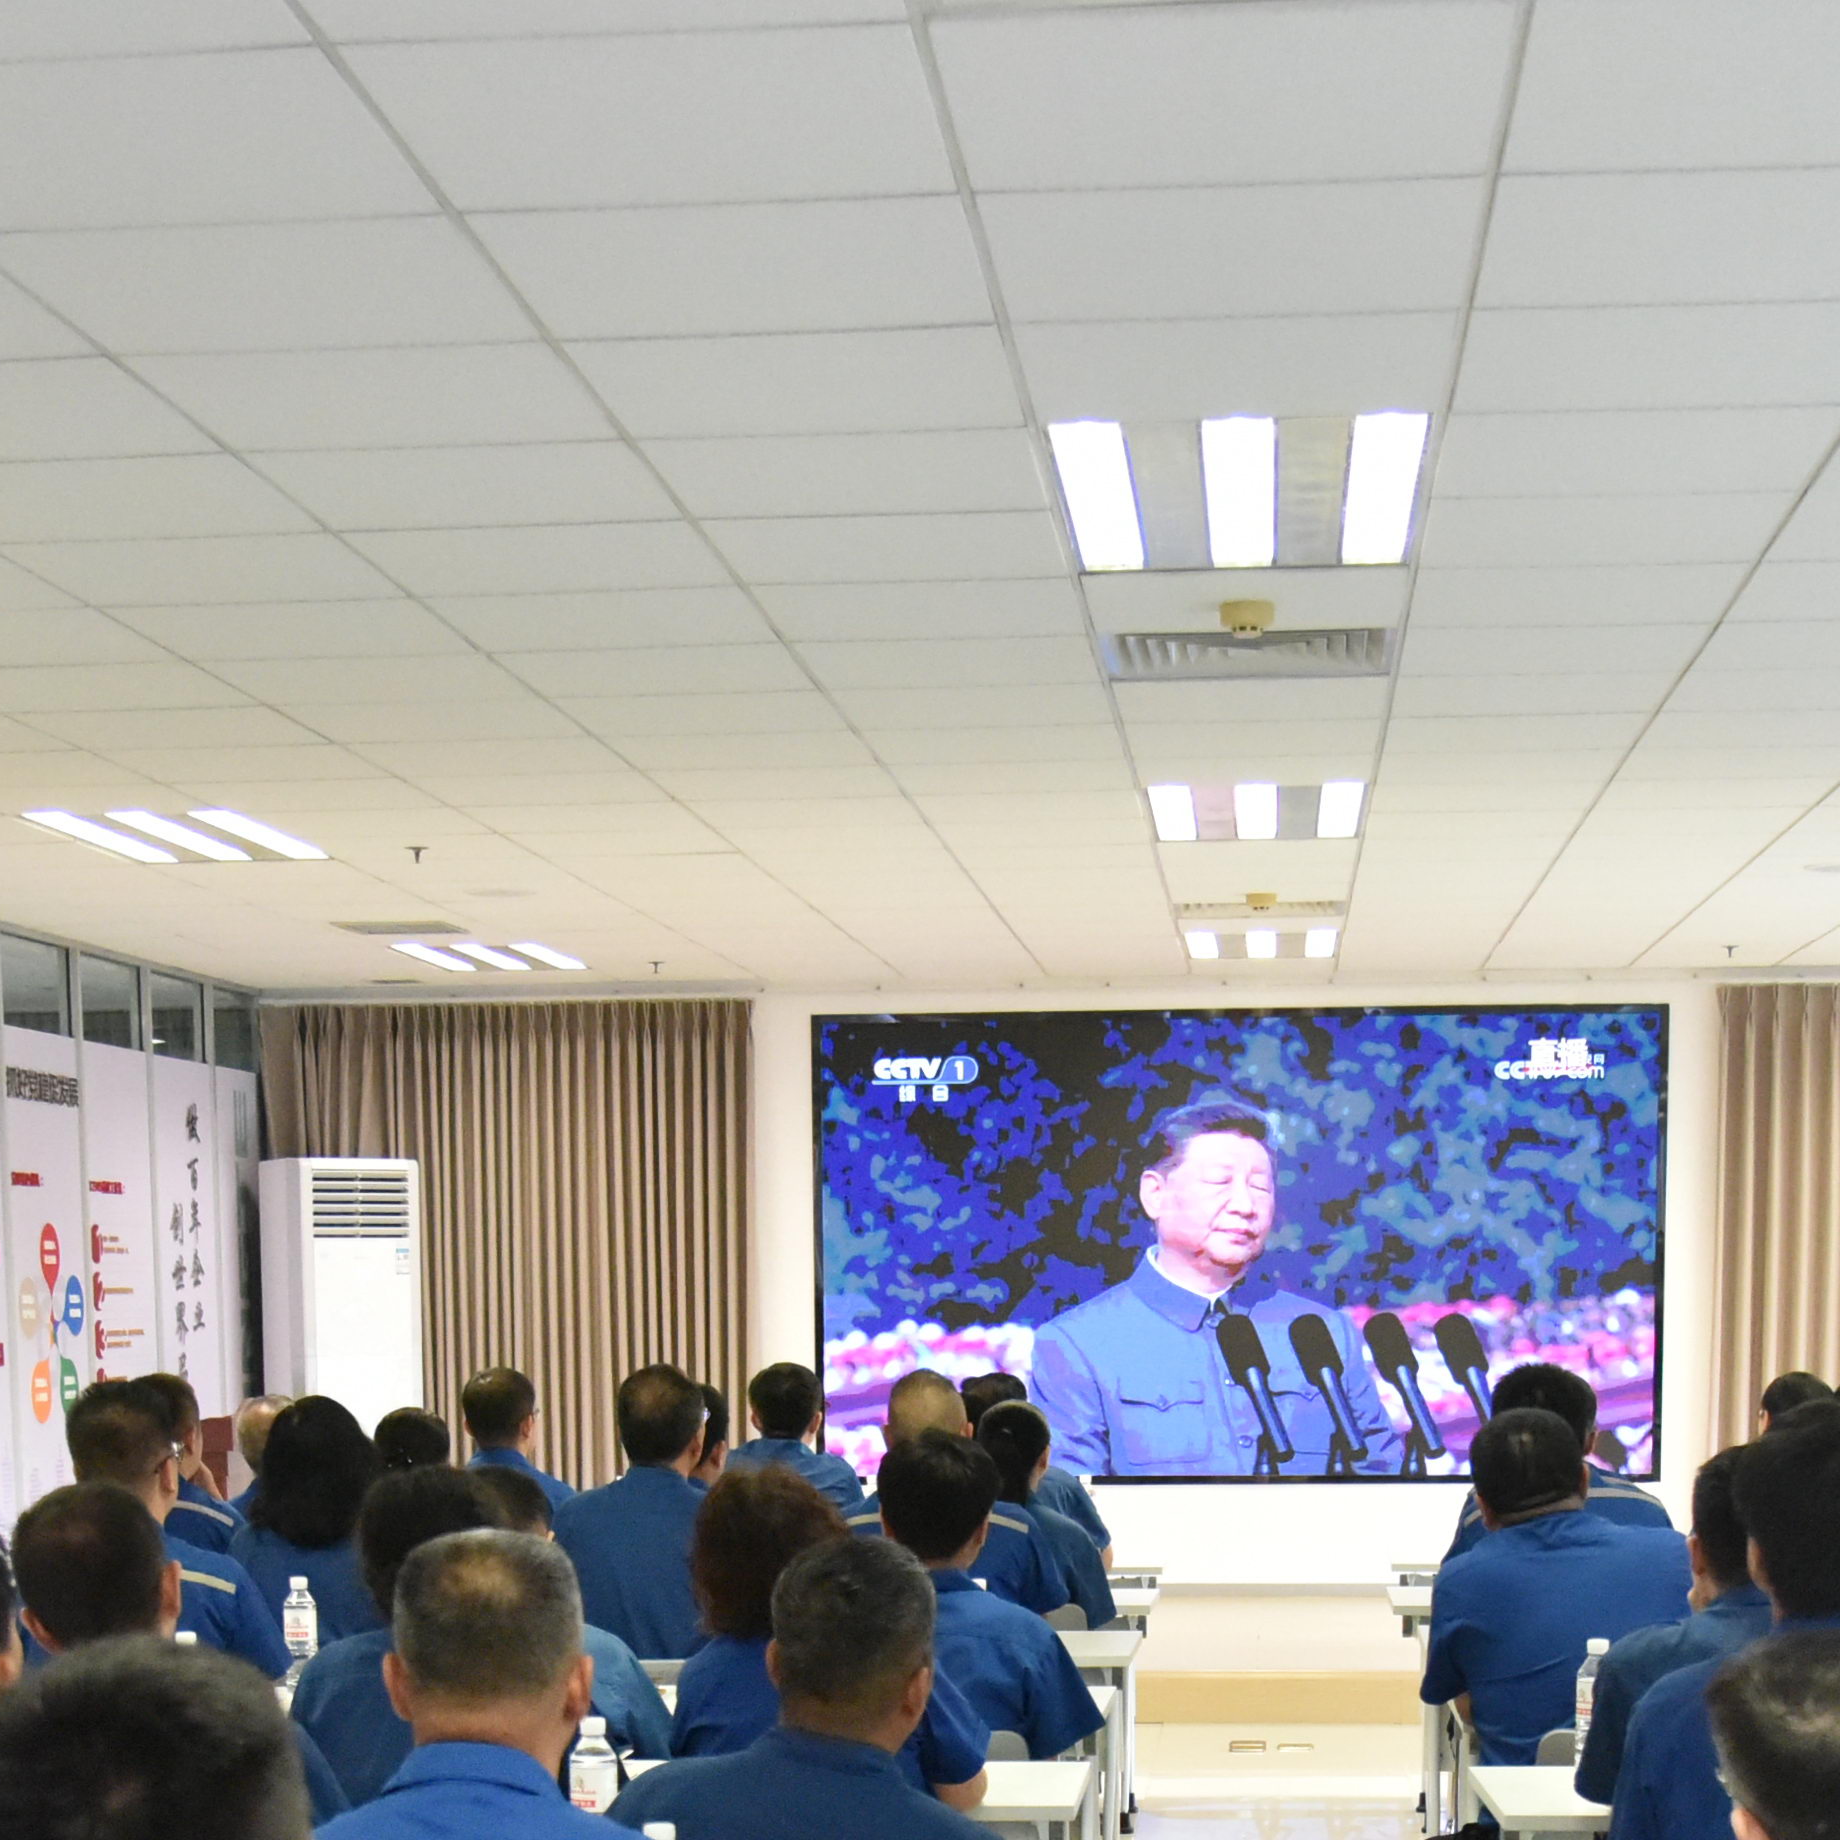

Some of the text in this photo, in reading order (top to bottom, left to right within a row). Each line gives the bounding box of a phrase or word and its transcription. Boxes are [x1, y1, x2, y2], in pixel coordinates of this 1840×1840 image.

[1528, 1036, 1589, 1068] 直播
[873, 1056, 965, 1081] CCTV 1
